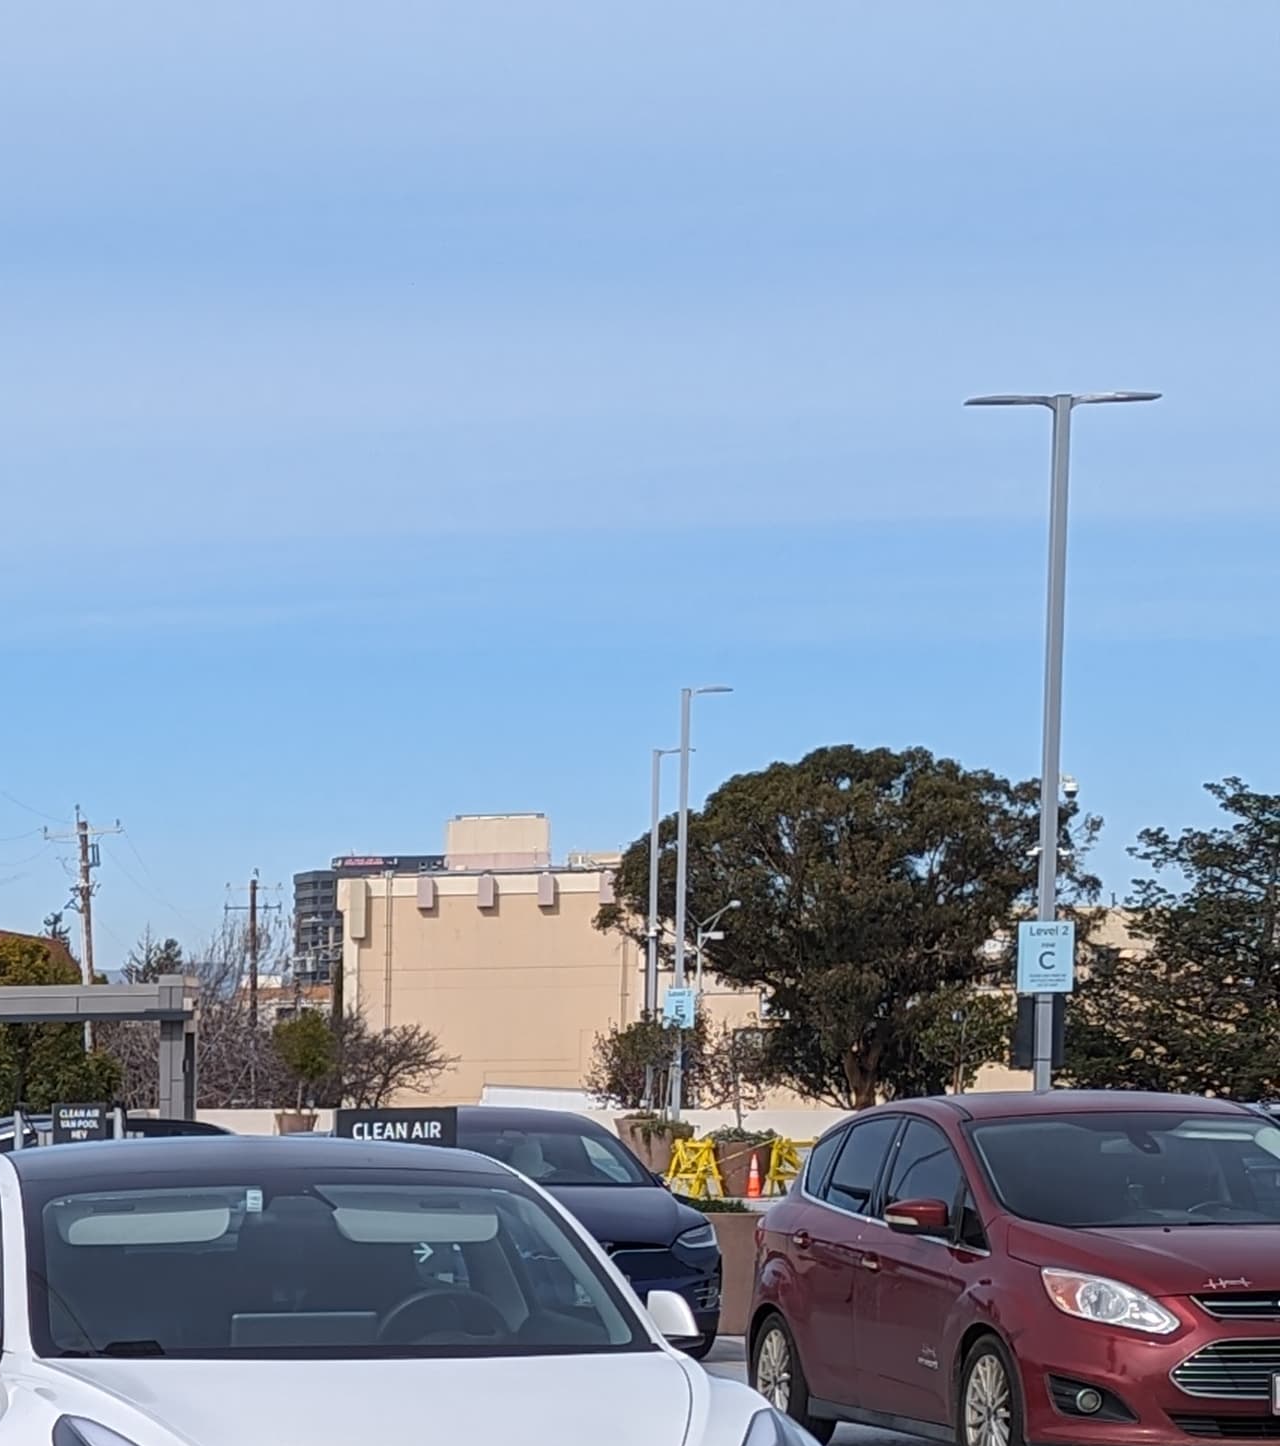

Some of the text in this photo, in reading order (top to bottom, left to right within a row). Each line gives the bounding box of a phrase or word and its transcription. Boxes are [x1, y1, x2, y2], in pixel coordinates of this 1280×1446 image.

[1028, 925, 1069, 937] Level 2
[1038, 951, 1056, 970] C
[59, 1109, 100, 1118] CLEAN AIR
[60, 1119, 99, 1128] VAN POOL
[352, 1121, 442, 1140] CLEAN AIR
